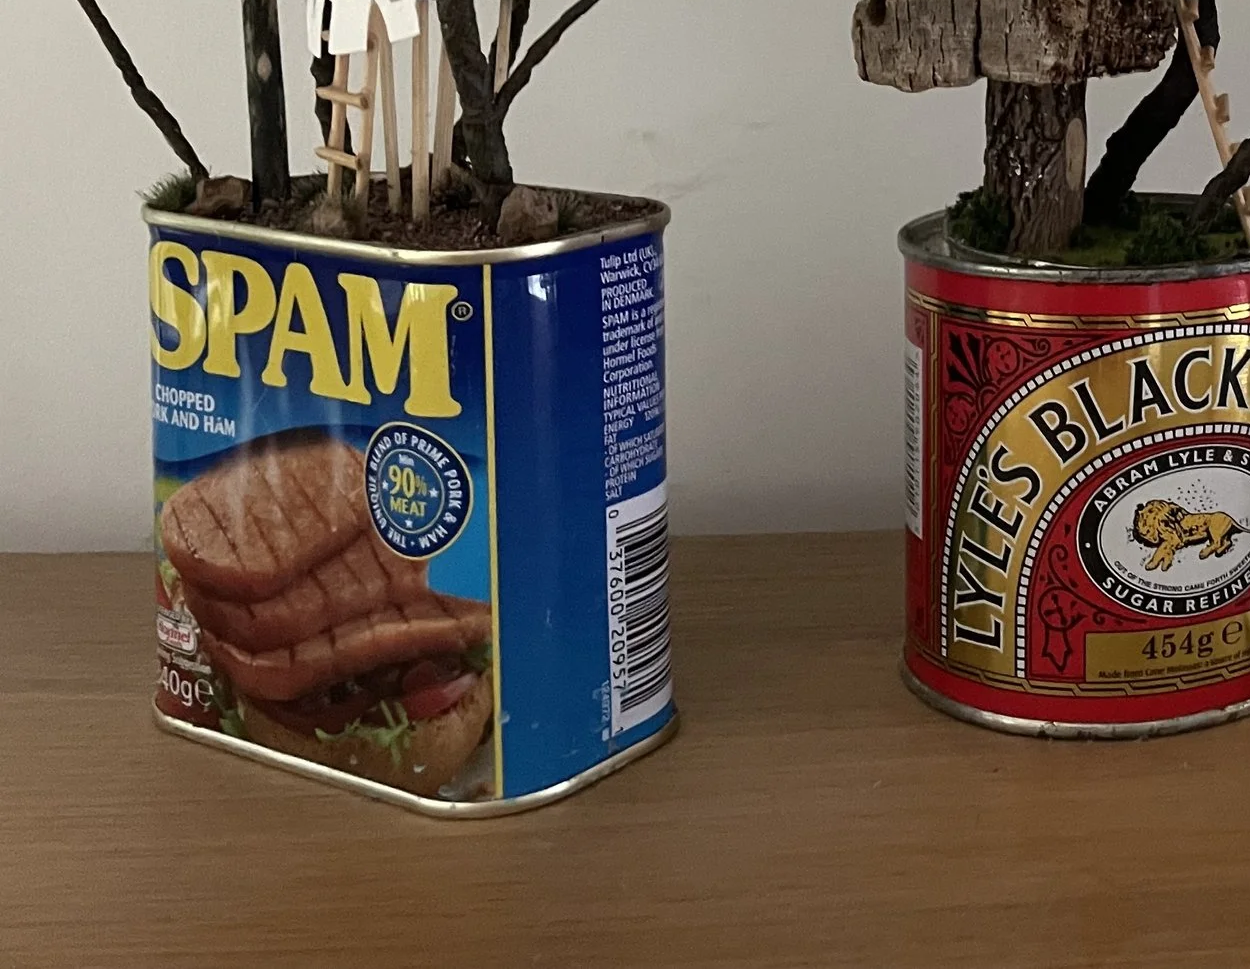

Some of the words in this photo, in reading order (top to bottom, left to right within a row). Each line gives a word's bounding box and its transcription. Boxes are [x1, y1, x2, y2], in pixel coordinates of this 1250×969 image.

[600, 254, 621, 269] Tulip
[623, 248, 638, 264] Ltd
[600, 263, 642, 284] Warwick,
[601, 278, 648, 299] PRODUCED
[602, 299, 612, 311] IN
[613, 287, 655, 309] DENMARK
[151, 240, 463, 418] SPAM
[602, 311, 630, 329] SPAM
[631, 309, 639, 321] is
[602, 320, 646, 342] trademark
[603, 340, 629, 357] under
[630, 331, 656, 348] license
[603, 350, 636, 370] Hormel
[637, 343, 657, 360] Foods
[603, 359, 654, 383] Corporation
[155, 383, 216, 412] CHOPPED
[603, 371, 659, 400] NUTRITIONAL
[603, 381, 660, 411] INFORMATION
[171, 409, 200, 430] AND
[203, 414, 236, 438] HAM
[604, 404, 636, 423] TYPICAL
[604, 416, 635, 435] ENERGY
[394, 432, 408, 445] OF
[604, 433, 617, 446] FAT
[411, 435, 450, 469] PRIME
[443, 469, 463, 509] PORK
[605, 470, 637, 489] PROTEIN
[1094, 460, 1159, 512] ABRAM
[1168, 449, 1215, 467] LYLE
[1223, 449, 1233, 462] &
[368, 474, 387, 529] UNIQUE
[605, 485, 623, 501] SALT
[390, 496, 428, 518] MEAT
[608, 509, 619, 519] 0
[387, 527, 407, 549] THE
[418, 523, 449, 549] HAM
[954, 442, 1044, 652] LYLE'S
[609, 548, 625, 616] 37600
[1113, 560, 1128, 575] OUT
[1127, 572, 1137, 580] OF
[1138, 578, 1152, 588] THE
[1153, 584, 1183, 592] STRONG
[1184, 583, 1205, 592] CAME
[1206, 573, 1229, 587] FORTH
[1102, 577, 1174, 613] SUGAR
[1141, 630, 1215, 660] 454g
[610, 627, 627, 690] 20957
[160, 665, 193, 707] 40g
